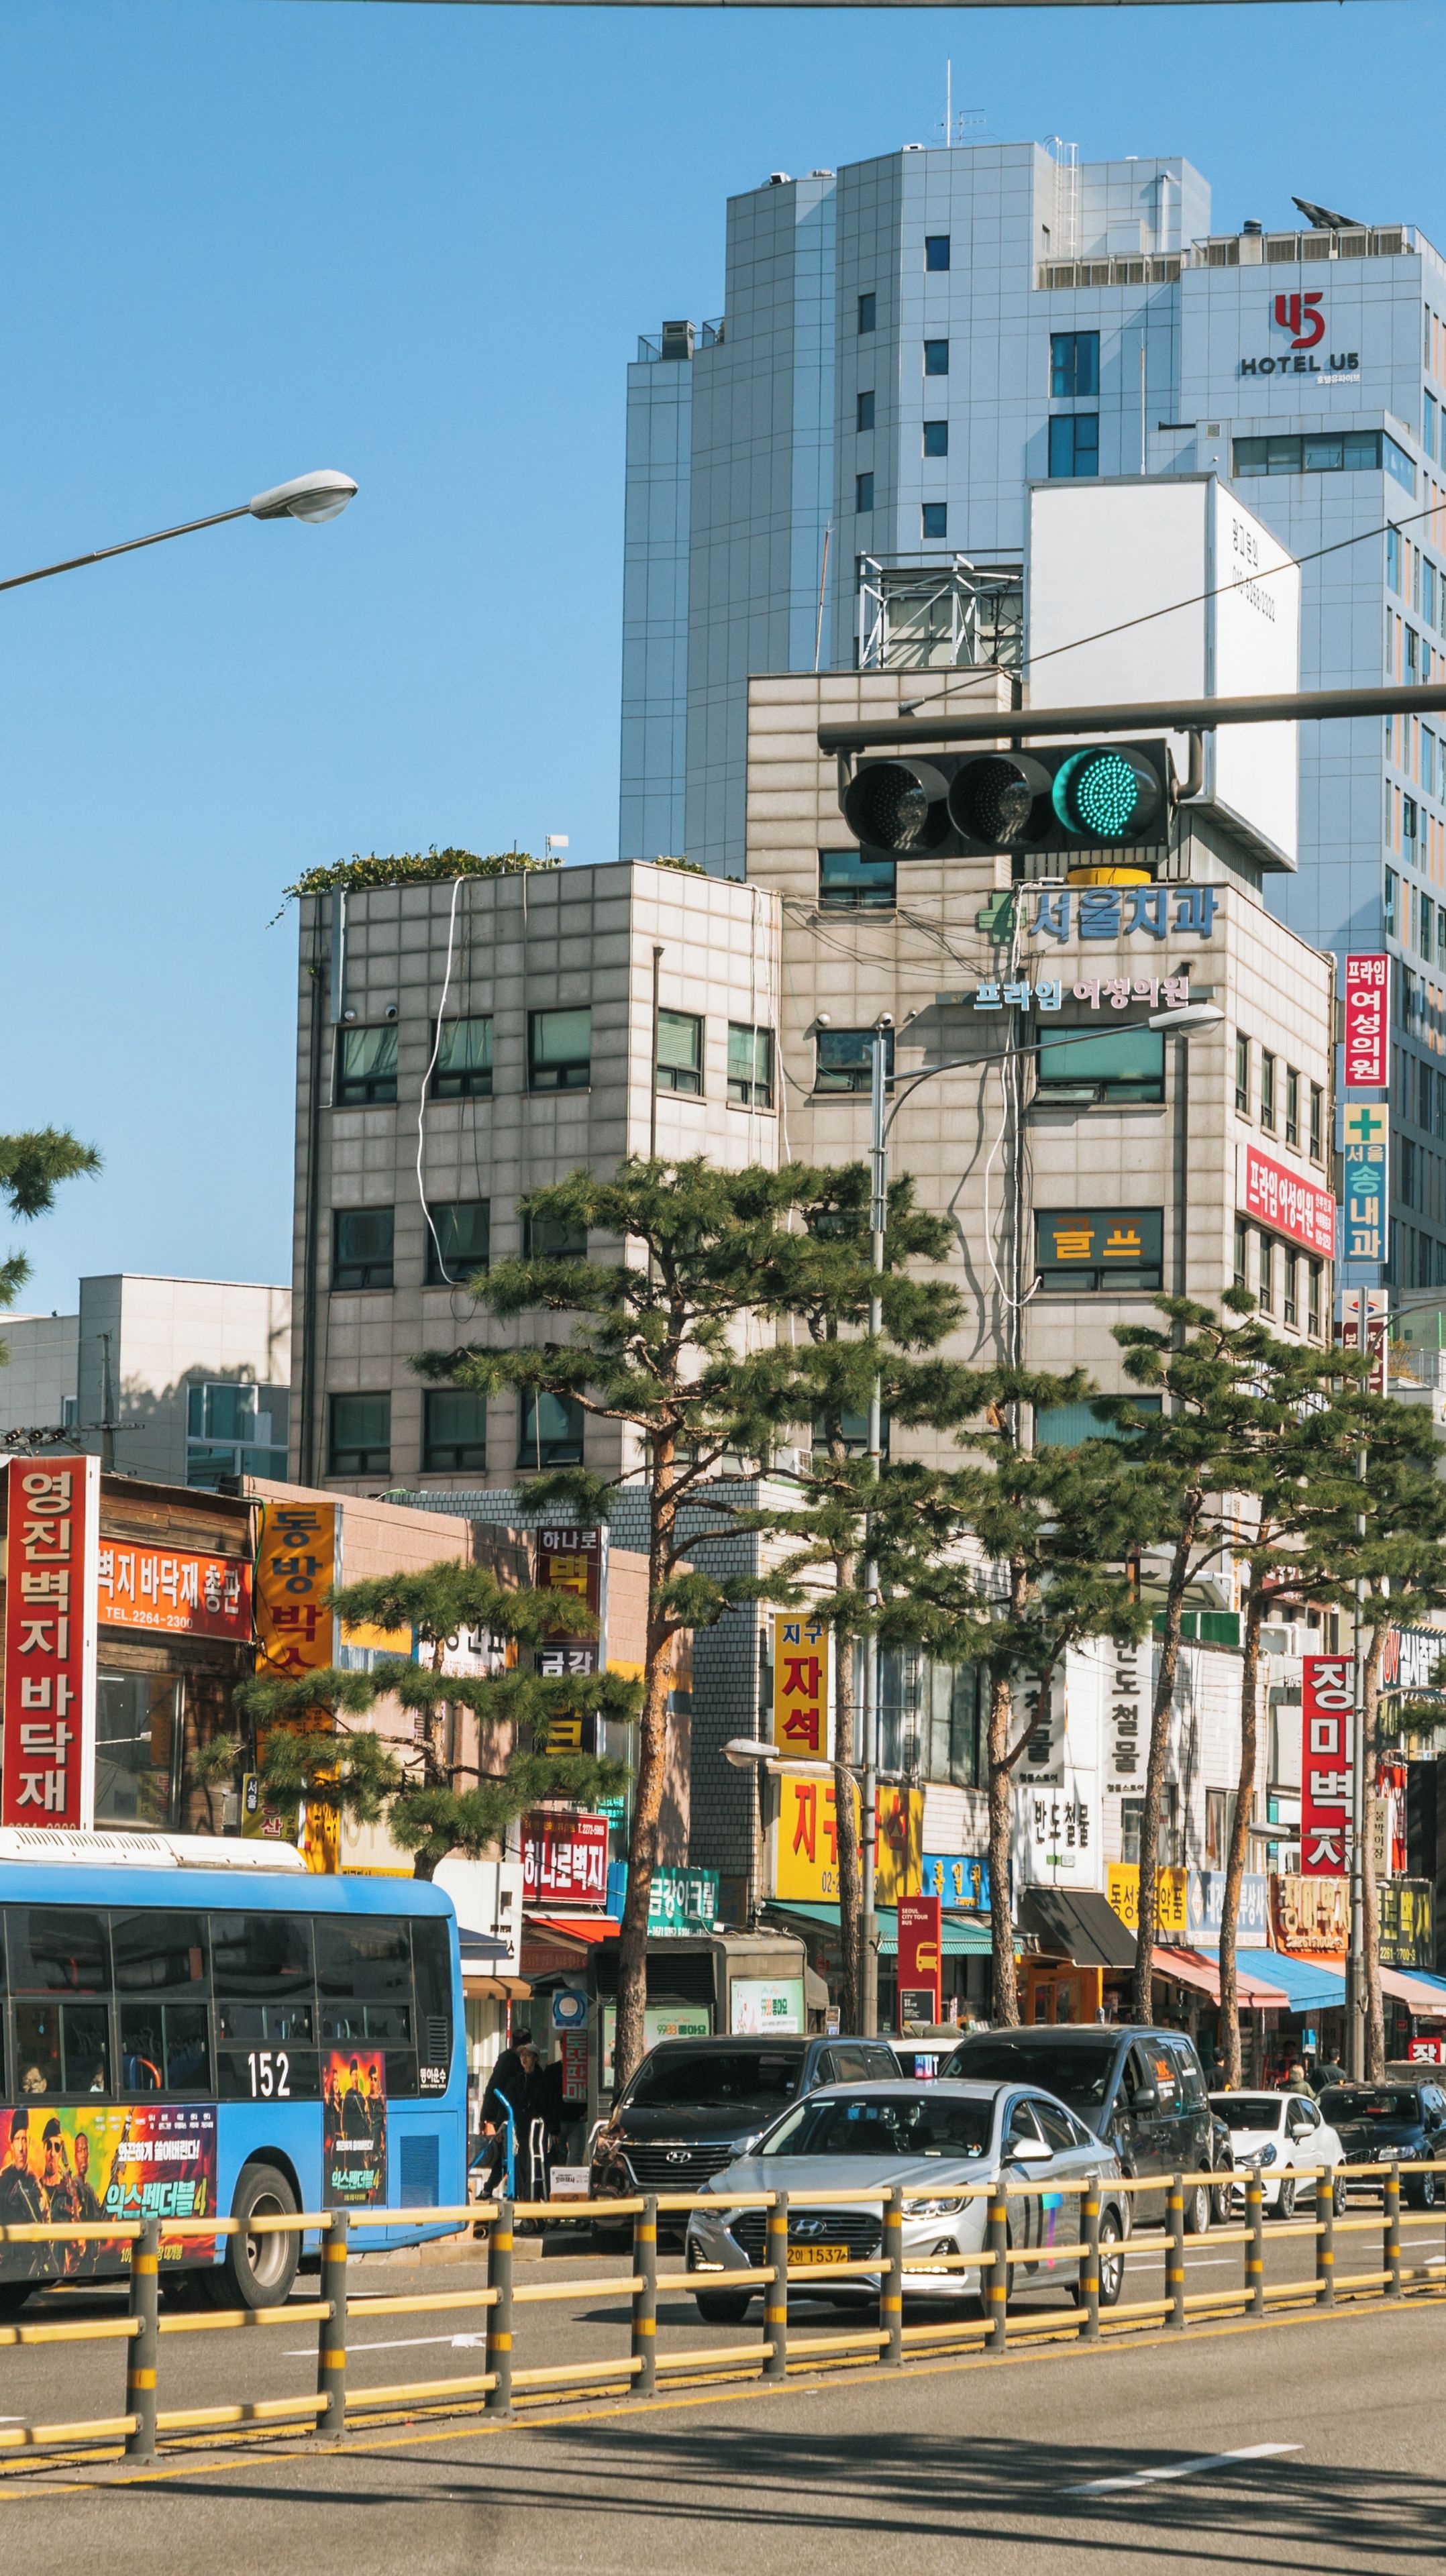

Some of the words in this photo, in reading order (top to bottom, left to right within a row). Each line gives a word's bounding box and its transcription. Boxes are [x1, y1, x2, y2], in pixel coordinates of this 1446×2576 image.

[1241, 355, 1321, 375] HOTEL
[1330, 352, 1359, 370] U5
[1316, 374, 1361, 384] 호텔유파이브
[1030, 887, 1219, 942] 서울치과
[1347, 960, 1386, 985] 프라임
[974, 979, 1062, 1011] 프라임
[1073, 975, 1190, 1009] 여성의원
[1349, 990, 1381, 1080] 여성의원
[1346, 1146, 1384, 1163] 서울
[1249, 1160, 1278, 1219] 프라임
[1279, 1178, 1314, 1239] 여성의원
[1349, 1165, 1382, 1258] 송내과
[1052, 1217, 1145, 1259] 골프
[542, 1530, 597, 1550] 하나로
[141, 1555, 199, 1609] 바닥재
[203, 1564, 241, 1615] 총판
[105, 1605, 193, 1629] TEL.2264-2300
[782, 1623, 823, 1646] 지구
[541, 1650, 594, 1678] 금강
[781, 1656, 823, 1751] 자석
[16, 1674, 74, 1813] 바닥재
[1307, 1661, 1355, 1873] 장미벽지
[246, 1780, 258, 1809] 서울
[1034, 1801, 1090, 1848] 반도철물
[524, 1839, 603, 1891] 하나로벽지
[648, 1878, 715, 1919] 금강아크릴
[772, 1998, 788, 2016] 좋아요
[657, 2024, 677, 2036] 9988
[678, 2025, 707, 2035] 좋아요
[247, 2052, 291, 2097] 152
[420, 2068, 447, 2084] 동아운수
[566, 2031, 587, 2100] 로또판매
[118, 2141, 154, 2162] 화끈하게
[807, 2249, 843, 2263] 1537
